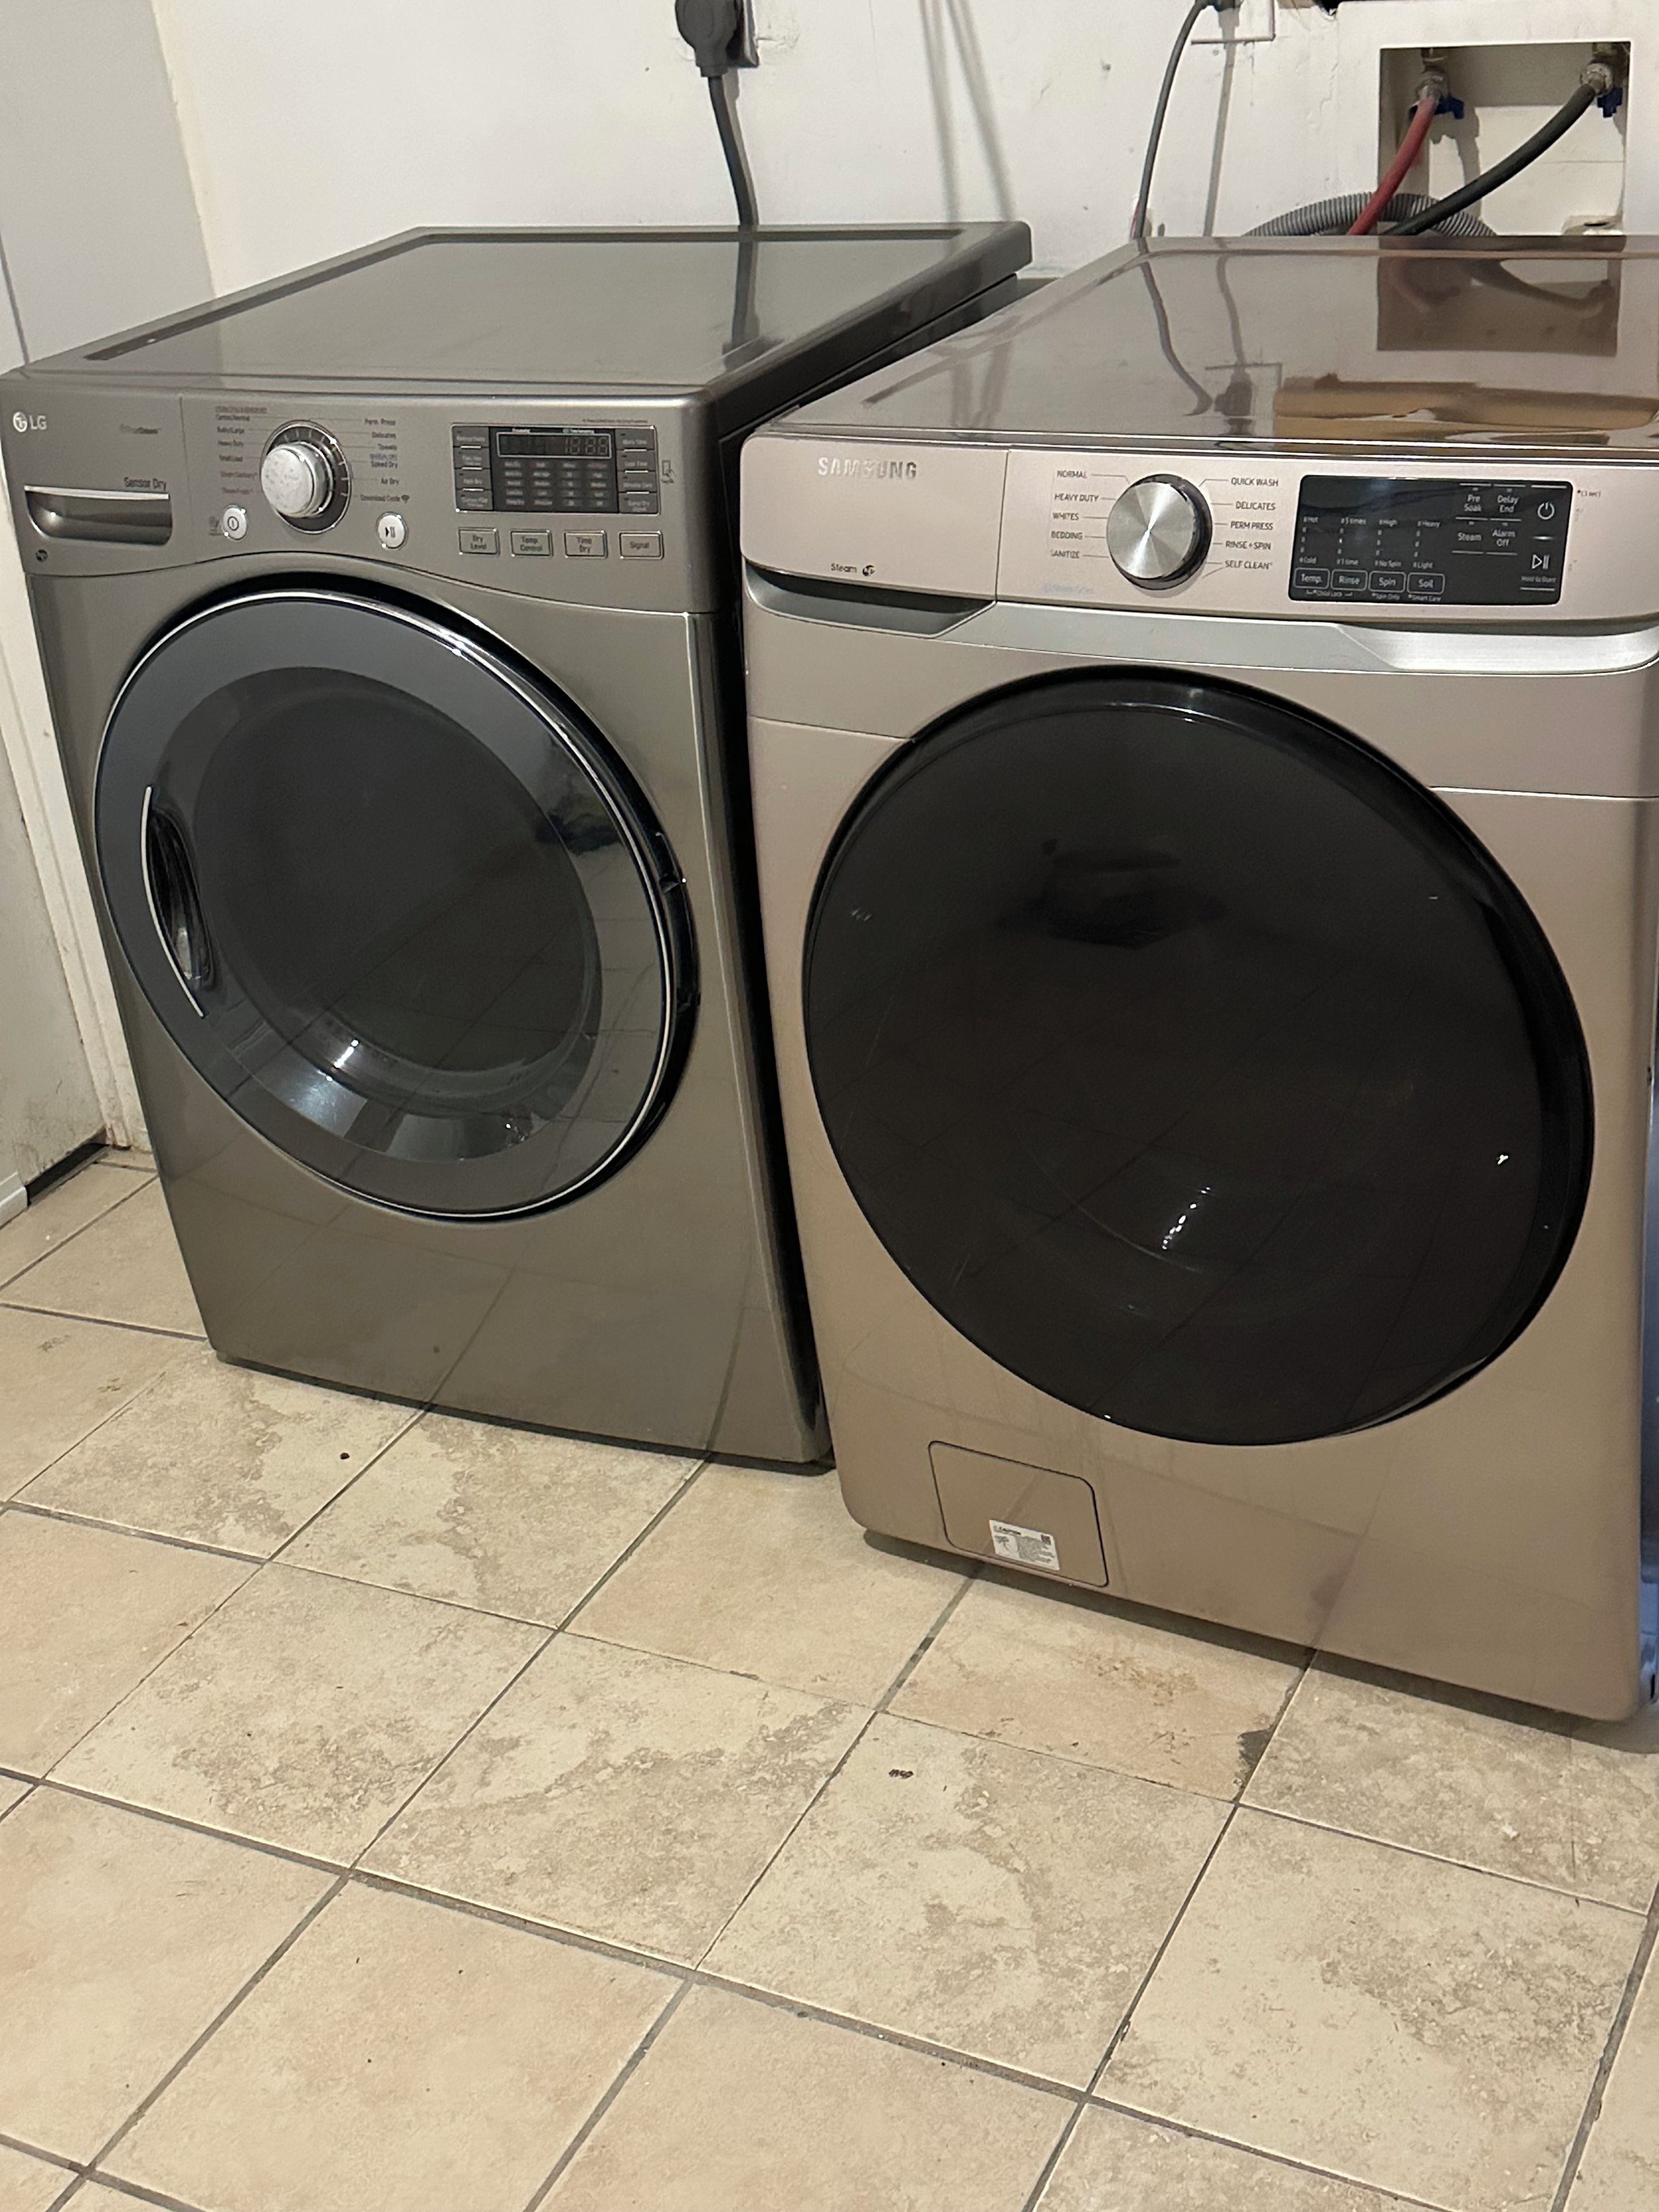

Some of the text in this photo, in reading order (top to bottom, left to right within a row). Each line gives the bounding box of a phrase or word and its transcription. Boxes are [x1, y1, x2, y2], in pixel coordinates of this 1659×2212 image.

[30, 415, 47, 430] LG
[818, 457, 917, 480] SAMSUNG
[1056, 469, 1087, 479] NORMAL
[124, 477, 167, 491] Sensor Dry
[1231, 477, 1279, 487] QUICK WASH
[1054, 493, 1099, 502] HEAVY DUTY
[1467, 494, 1481, 503] Pre
[1498, 495, 1519, 505] Delay
[1236, 501, 1276, 511] DELICATES
[1464, 503, 1482, 512] Soak
[1499, 505, 1514, 513] End
[1052, 512, 1080, 520] WHITES
[1230, 521, 1274, 531] PERM PRESS
[472, 534, 483, 543] Dry
[1051, 531, 1083, 540] BEDDING
[1457, 532, 1482, 541] Steam
[1492, 529, 1516, 538] Alarm
[1225, 540, 1248, 548] RINSE
[1253, 541, 1271, 550] SPIN
[1496, 538, 1509, 547] Off
[579, 544, 590, 554] Dry
[831, 563, 857, 573] Steam
[1225, 560, 1243, 569] SELF
[1339, 575, 1360, 585] Rinse
[1378, 577, 1396, 587] Spin
[1418, 578, 1434, 588] Soil
